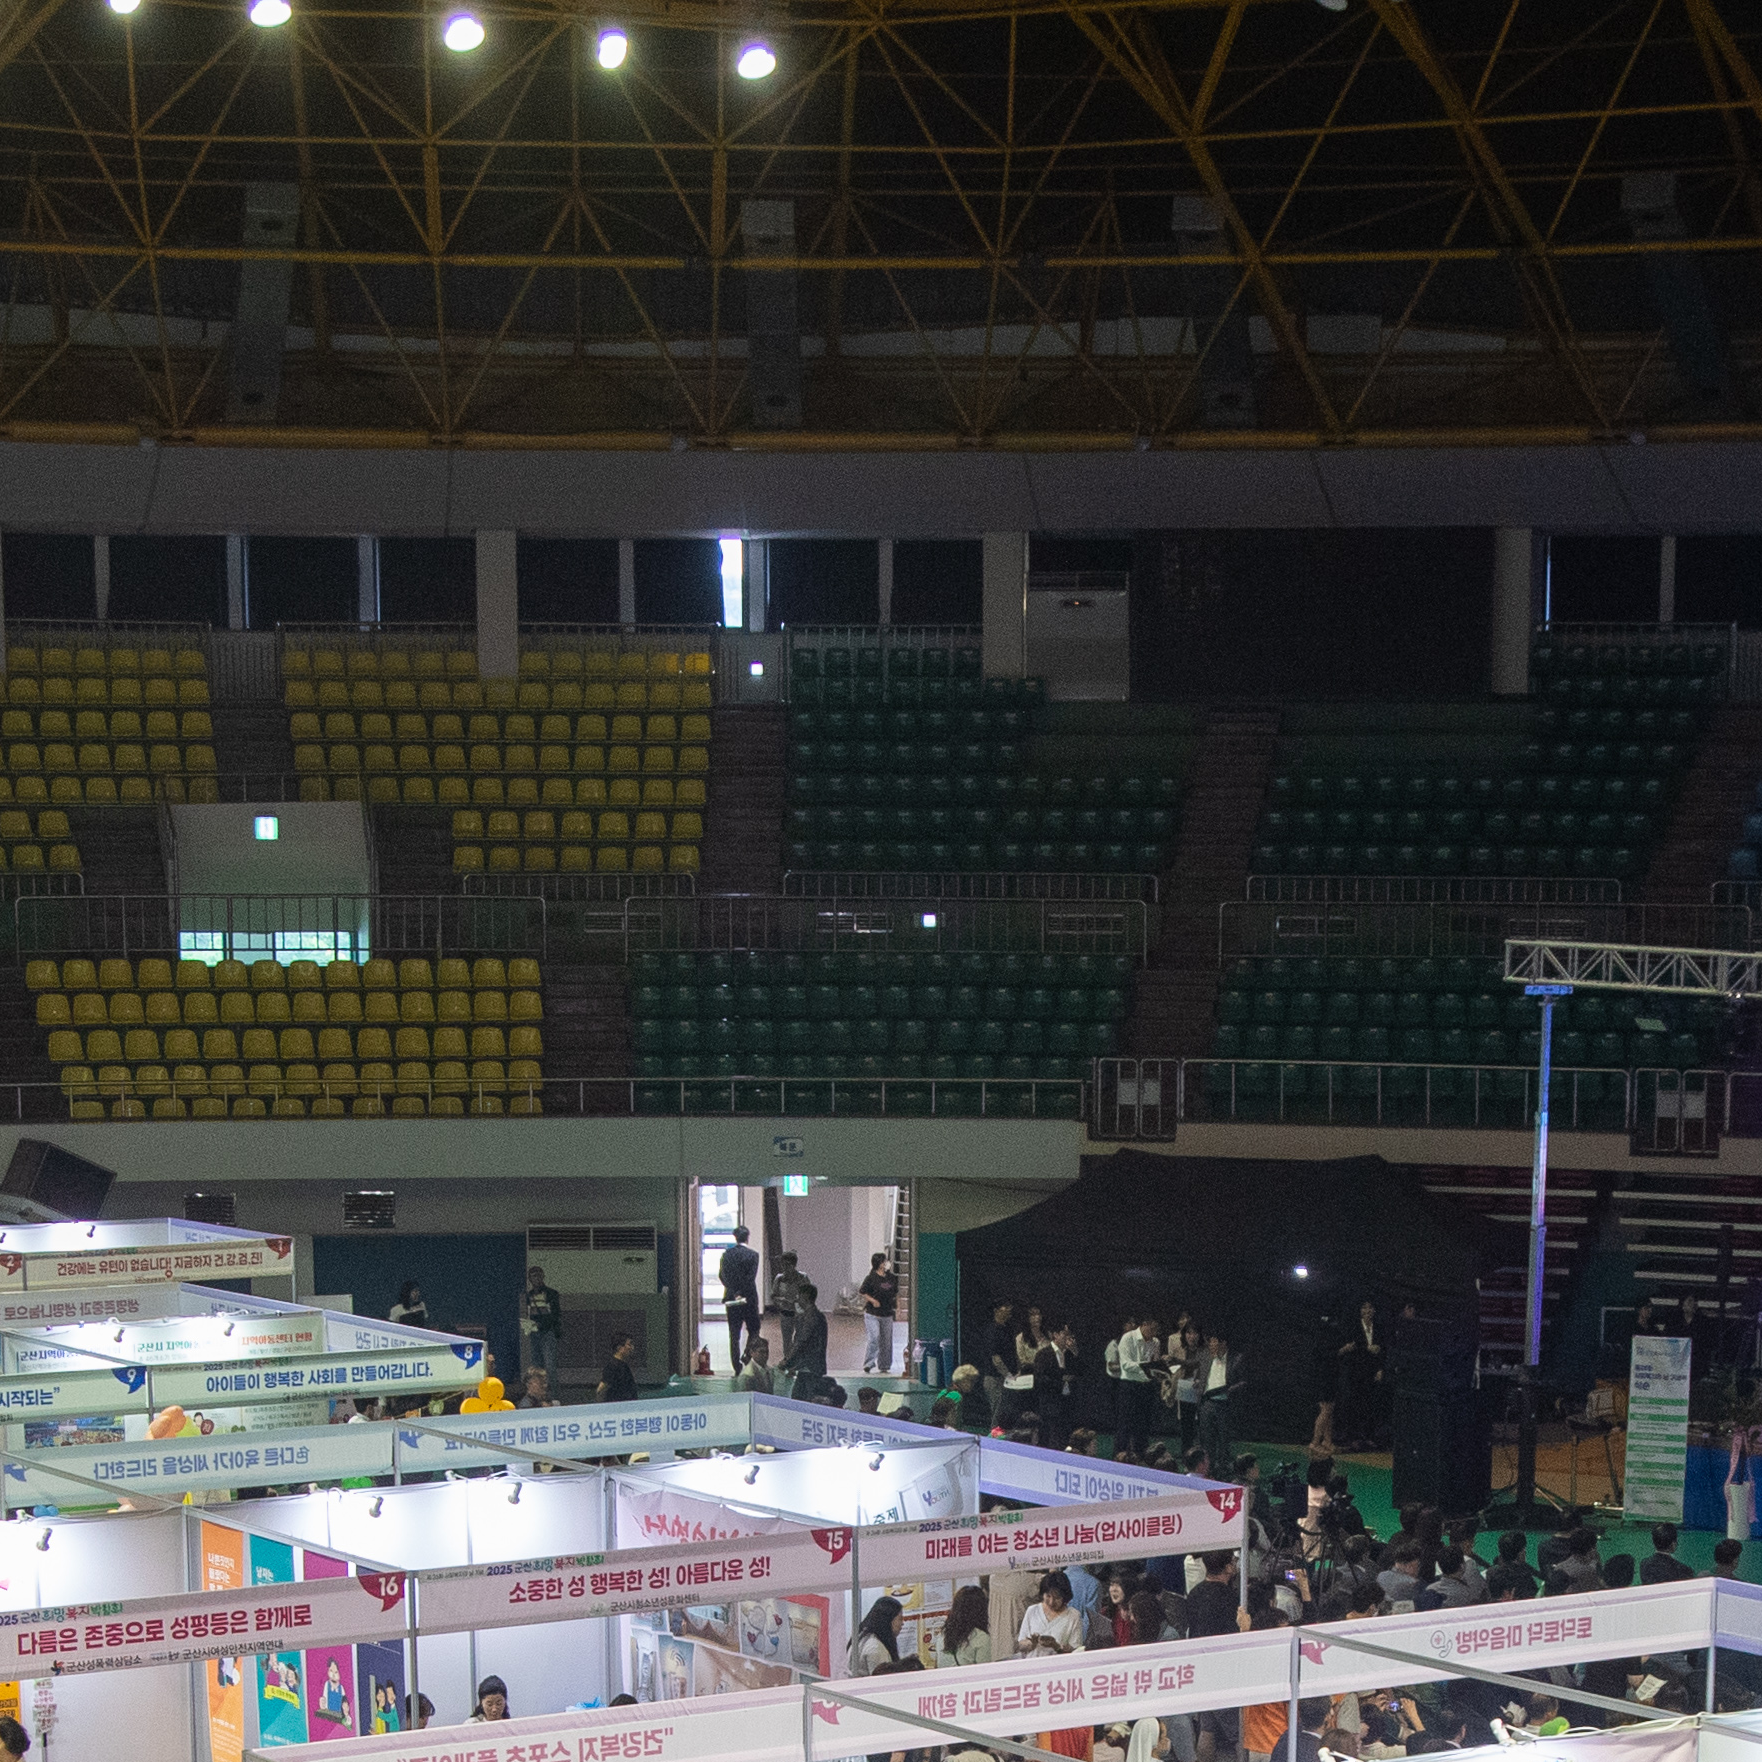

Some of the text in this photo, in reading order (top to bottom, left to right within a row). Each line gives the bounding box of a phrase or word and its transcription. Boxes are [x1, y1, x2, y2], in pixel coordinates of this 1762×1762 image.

[57, 1261, 96, 1276] 건강에는
[99, 1259, 128, 1274] 유턴이
[174, 1255, 212, 1269] 지금하자
[464, 1346, 474, 1359] 8
[127, 1370, 137, 1383] 9
[206, 1361, 434, 1393] 아이들이 행복한 사회를 만들어갑니다.
[1219, 1492, 1236, 1510] 14
[827, 1531, 843, 1550] 15
[925, 1514, 1182, 1560] 미래를 여는 청소년 나눔(업사이클링)
[378, 1577, 398, 1596] 16
[509, 1556, 771, 1604] 소중한 성 행복한 성! 아름다운 성!
[20, 1611, 40, 1625] 군산
[67, 1605, 90, 1621] 복지
[17, 1604, 312, 1656] 다름은 존중으로 성평등은 함께로
[66, 1654, 143, 1674] 군산성폭력상담소
